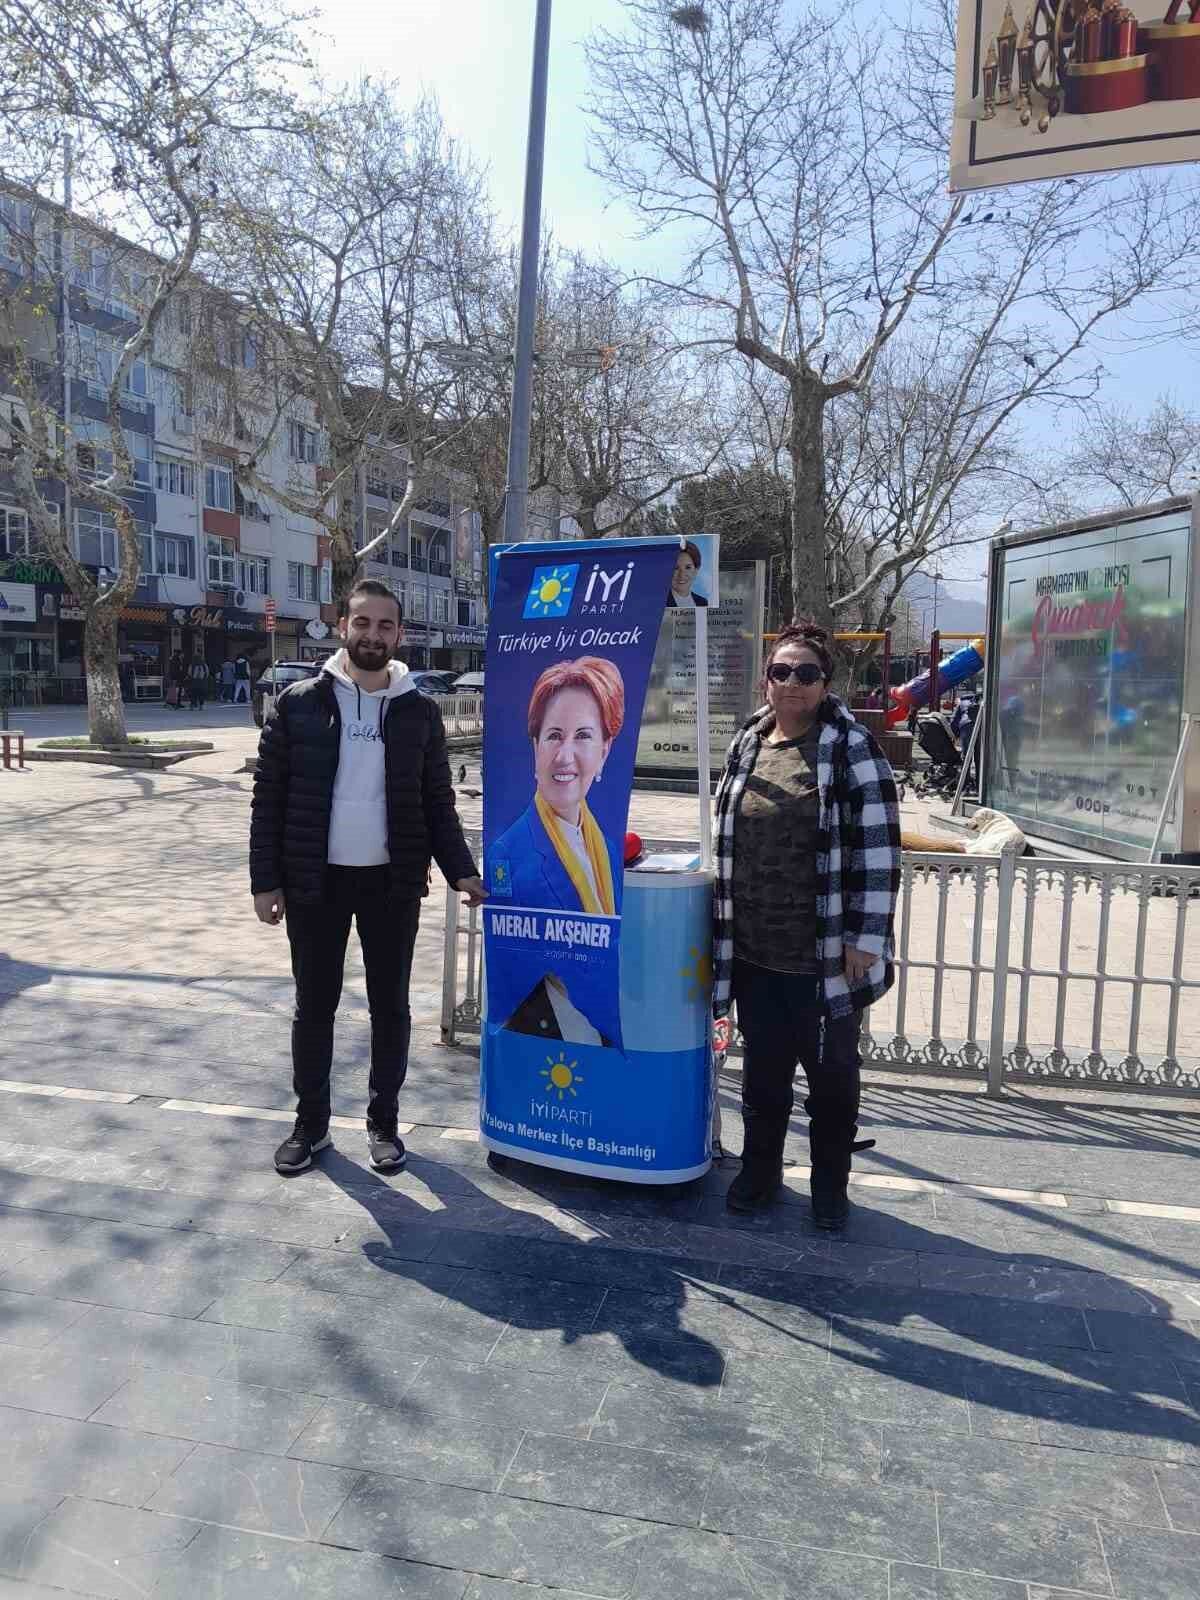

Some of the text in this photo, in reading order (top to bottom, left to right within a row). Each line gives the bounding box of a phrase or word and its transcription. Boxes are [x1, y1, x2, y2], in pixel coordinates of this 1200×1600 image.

[584, 561, 635, 602] İYİ
[497, 632, 551, 654] Türkiye
[554, 626, 576, 651] İyi
[579, 625, 643, 648] Olacak
[491, 913, 612, 949] MERAL AKŞENER
[517, 1123, 558, 1144] Merkez
[561, 1129, 584, 1150] İlçe
[587, 1136, 656, 1162] Başkanlığı
